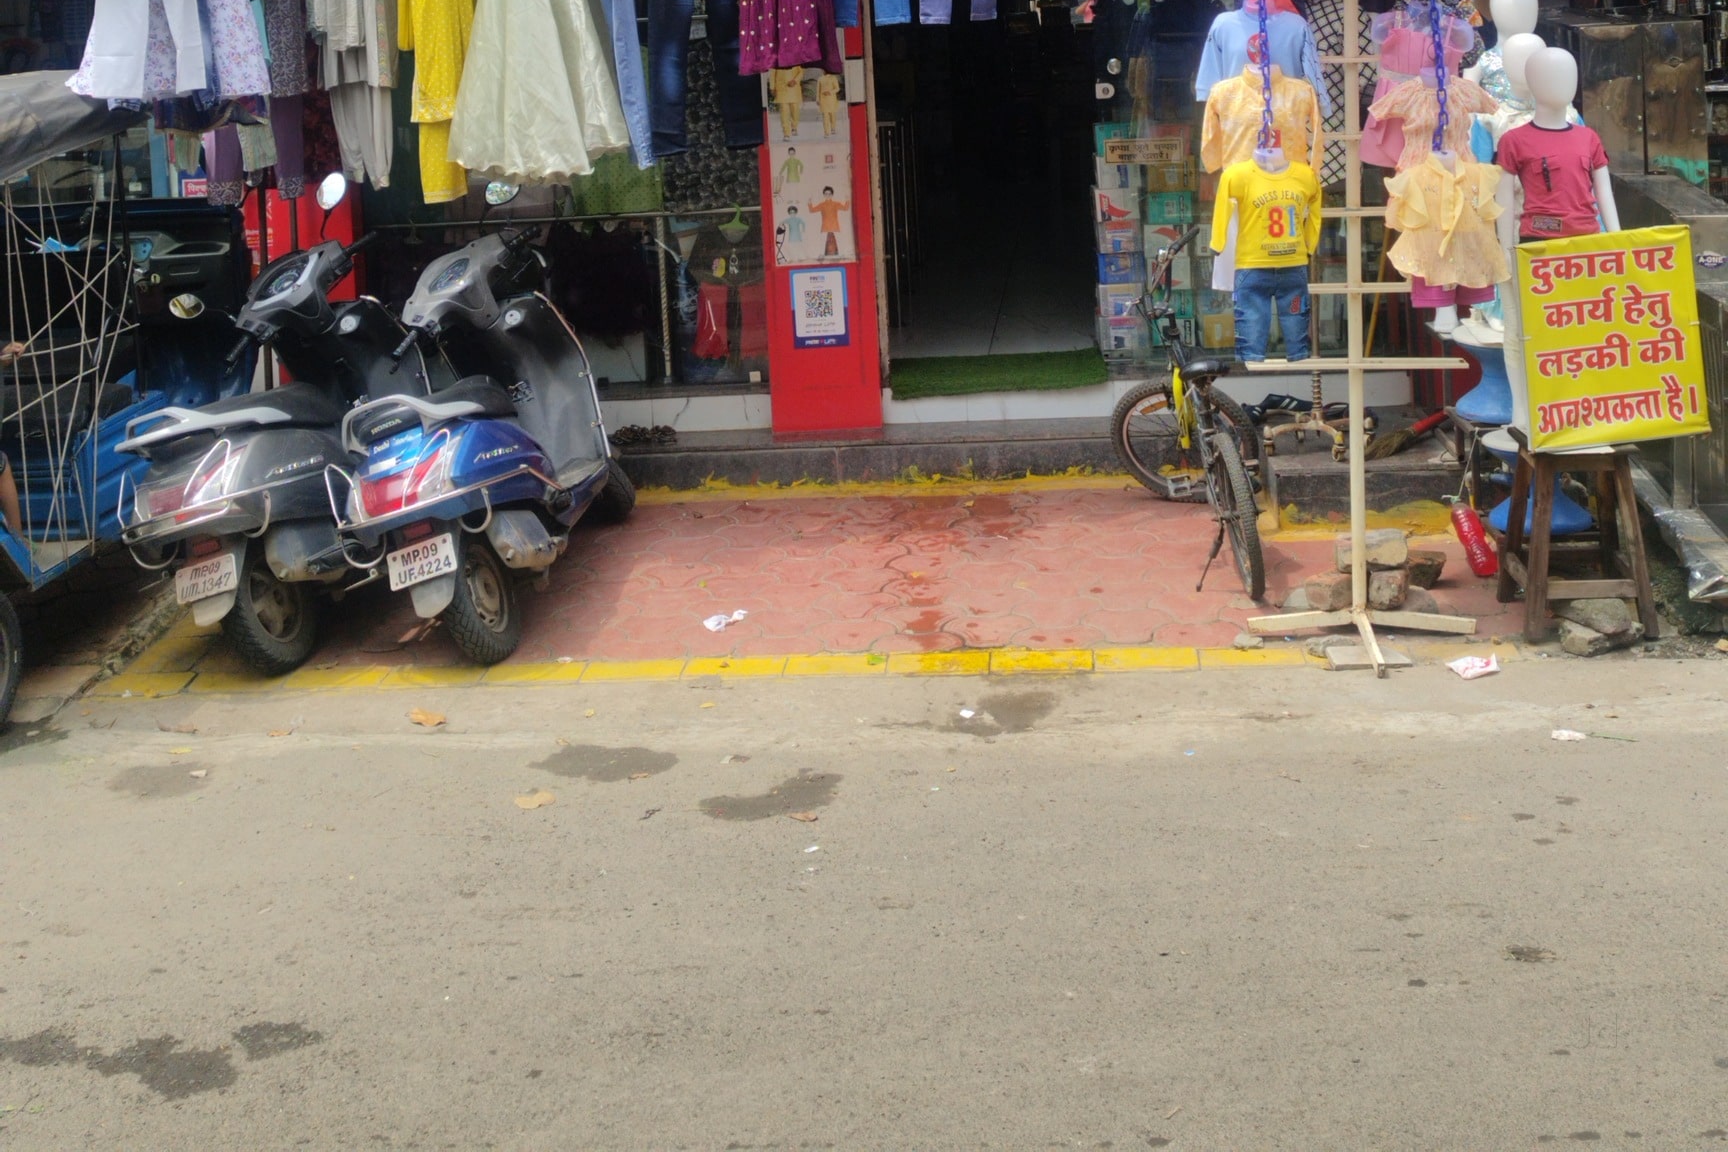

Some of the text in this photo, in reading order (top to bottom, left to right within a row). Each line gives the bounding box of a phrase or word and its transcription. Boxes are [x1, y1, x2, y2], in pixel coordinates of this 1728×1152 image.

[1252, 190, 1279, 208] GUESS
[1268, 205, 1297, 238] 81
[1531, 245, 1674, 295] दुकान पर
[1543, 284, 1673, 328] कार्य हेतु
[1536, 327, 1685, 379] लड़की की
[1537, 389, 1662, 434] आवश्यकता
[400, 542, 439, 567] MP.09
